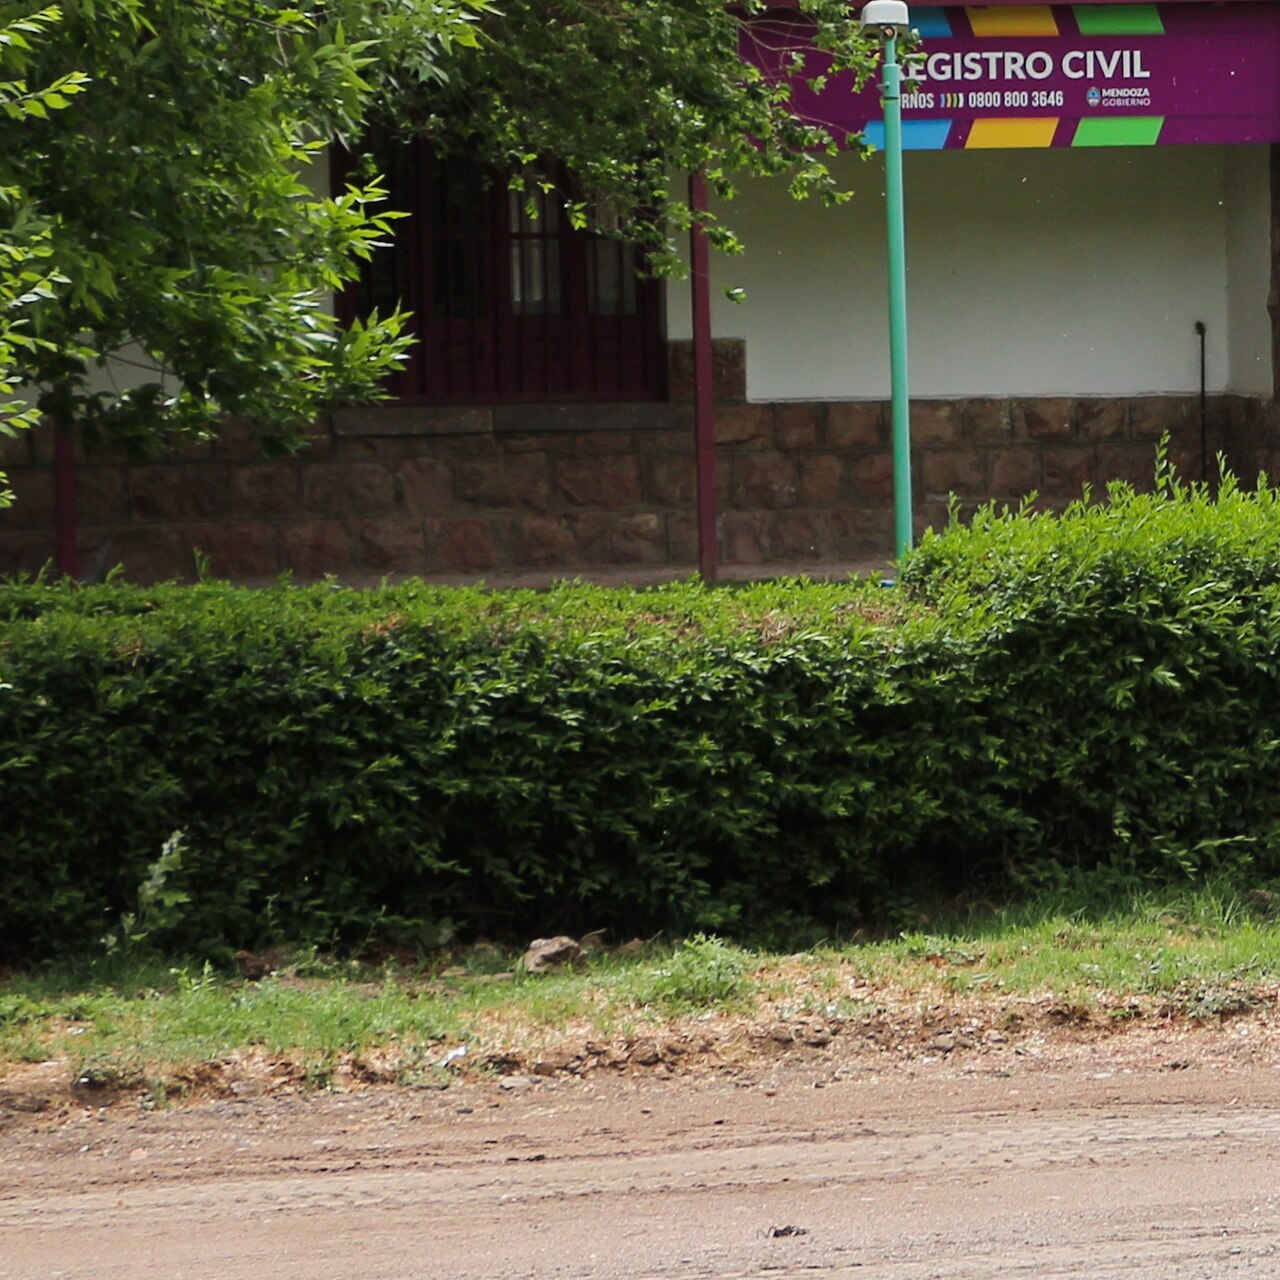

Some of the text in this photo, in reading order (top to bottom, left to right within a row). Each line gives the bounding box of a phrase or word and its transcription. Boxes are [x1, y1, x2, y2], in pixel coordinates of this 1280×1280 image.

[1062, 50, 1150, 79] CIVIL
[901, 90, 1064, 109] RNOS 0800 800 3646
[1101, 88, 1150, 97] MENDOZA
[1101, 98, 1151, 107] GOBIERNO
